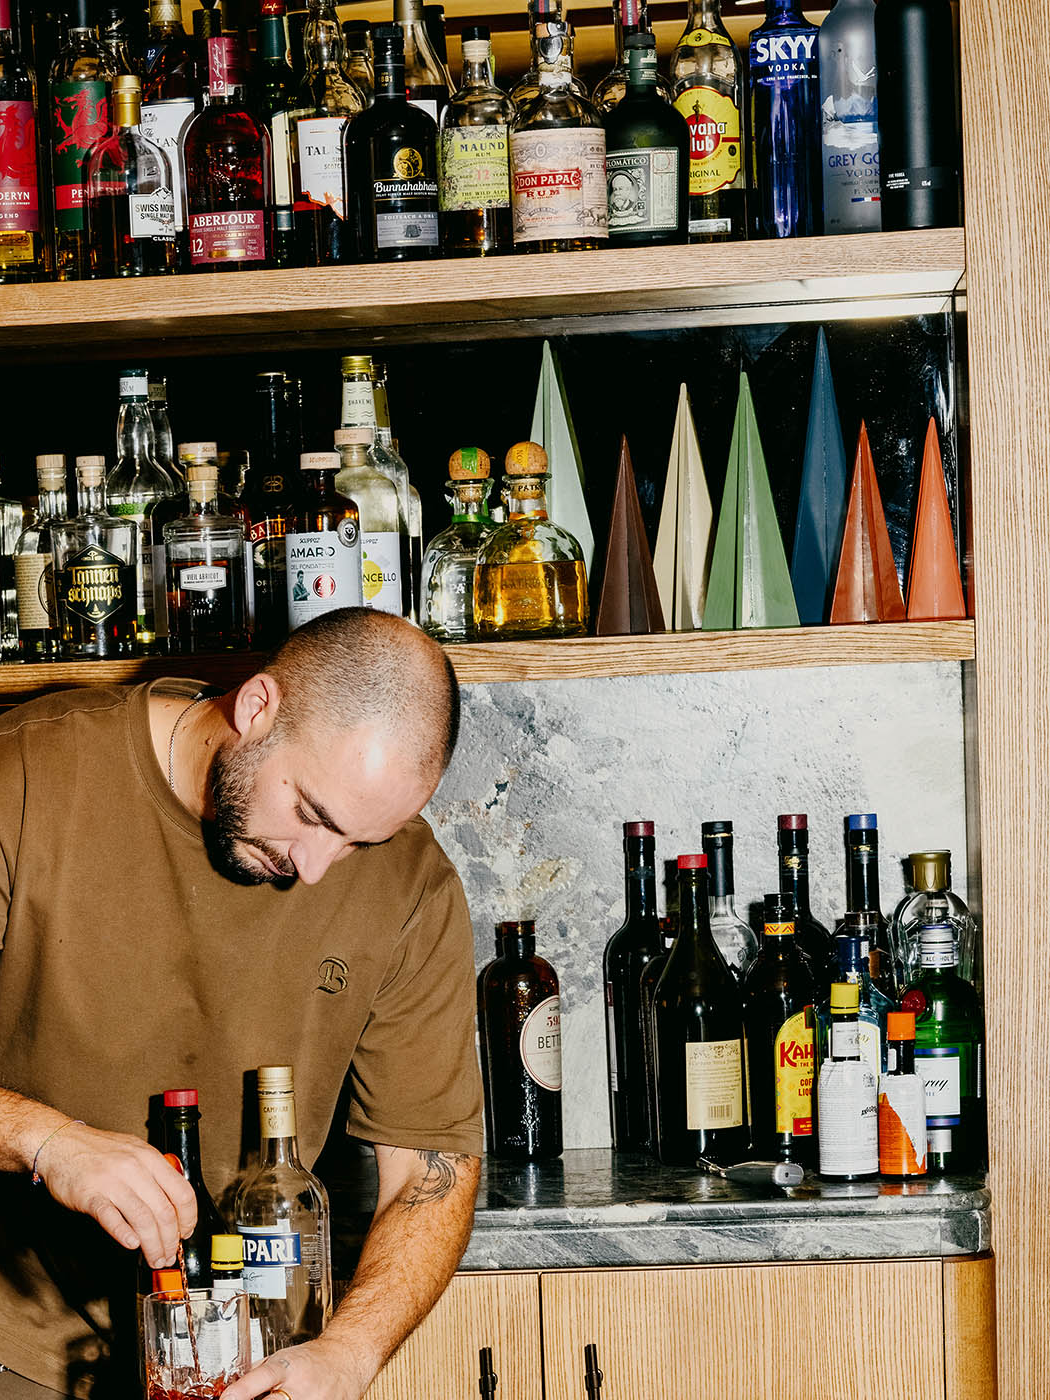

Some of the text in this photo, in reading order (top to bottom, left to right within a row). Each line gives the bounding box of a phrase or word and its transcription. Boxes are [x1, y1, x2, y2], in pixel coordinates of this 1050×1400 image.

[695, 33, 702, 42] 3
[756, 35, 816, 63] SKYY
[768, 63, 805, 73] VODKA
[212, 80, 225, 91] 12
[690, 122, 725, 135] vana
[460, 141, 505, 152] MAUND
[691, 136, 714, 152] lub
[828, 152, 857, 168] GREY
[478, 169, 490, 181] 12
[519, 174, 570, 187] DON PAPA
[374, 181, 438, 193] Bunnahabhain
[526, 189, 560, 198] RUM
[135, 203, 159, 212] SWISS
[192, 213, 256, 228] ABERLOUR
[192, 238, 204, 253] 12
[290, 547, 336, 559] AMARO
[71, 568, 119, 586] Tannen
[186, 573, 198, 581] VIEIL
[199, 572, 219, 580] ABRICOT
[67, 584, 123, 607] schnaps
[780, 1040, 814, 1068] KAH
[263, 1105, 289, 1113] CAMPARI
